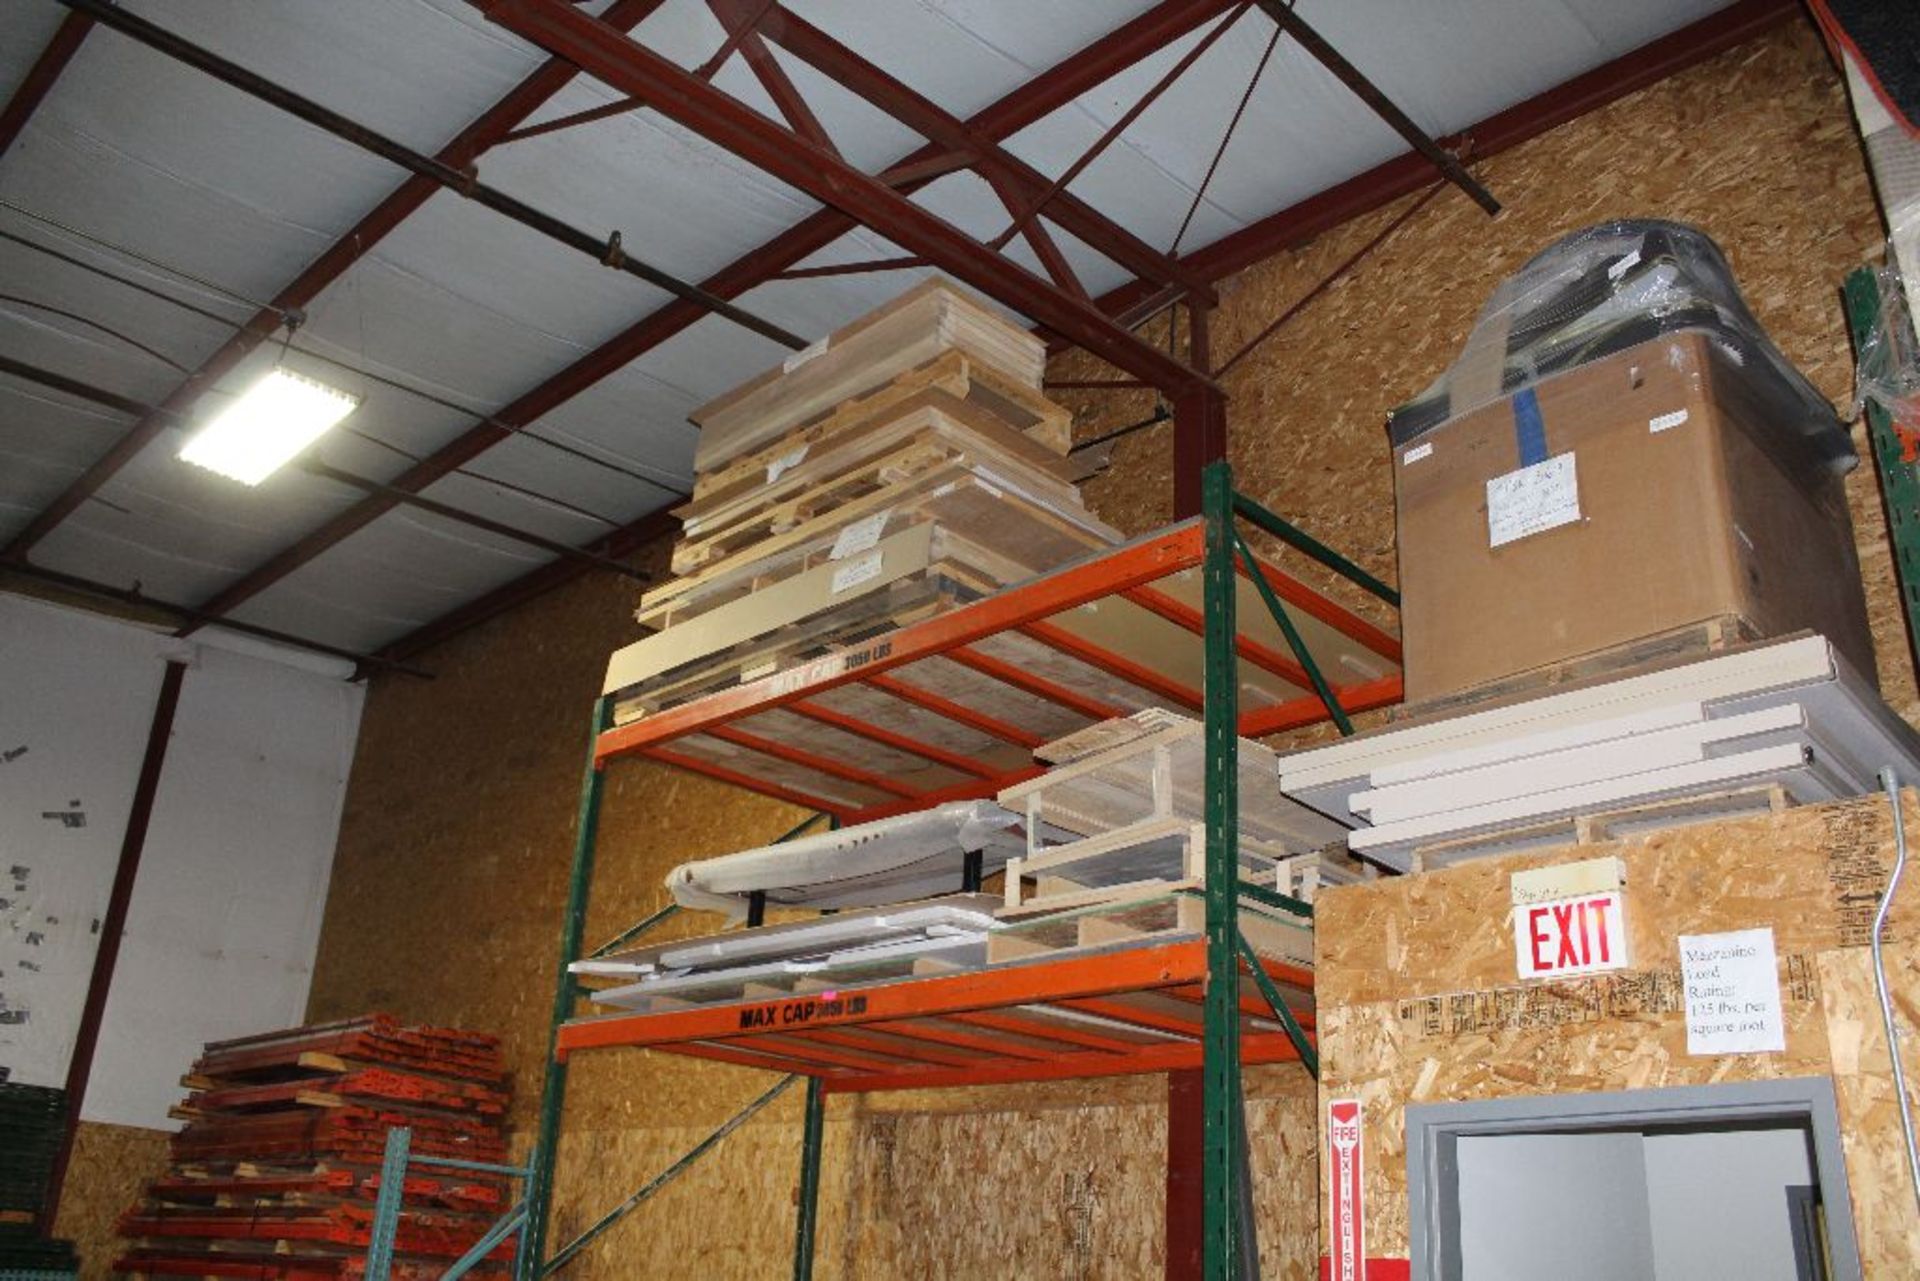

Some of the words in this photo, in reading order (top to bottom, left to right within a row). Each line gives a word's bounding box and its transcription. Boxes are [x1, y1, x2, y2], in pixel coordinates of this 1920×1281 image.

[1529, 898, 1611, 971] EXIT
[740, 1006, 777, 1028] MAX
[783, 1001, 815, 1023] CAP
[1691, 1022, 1734, 1037] square
[1334, 1126, 1356, 1141] FIRE
[1341, 1147, 1353, 1281] EXTINGUISH
